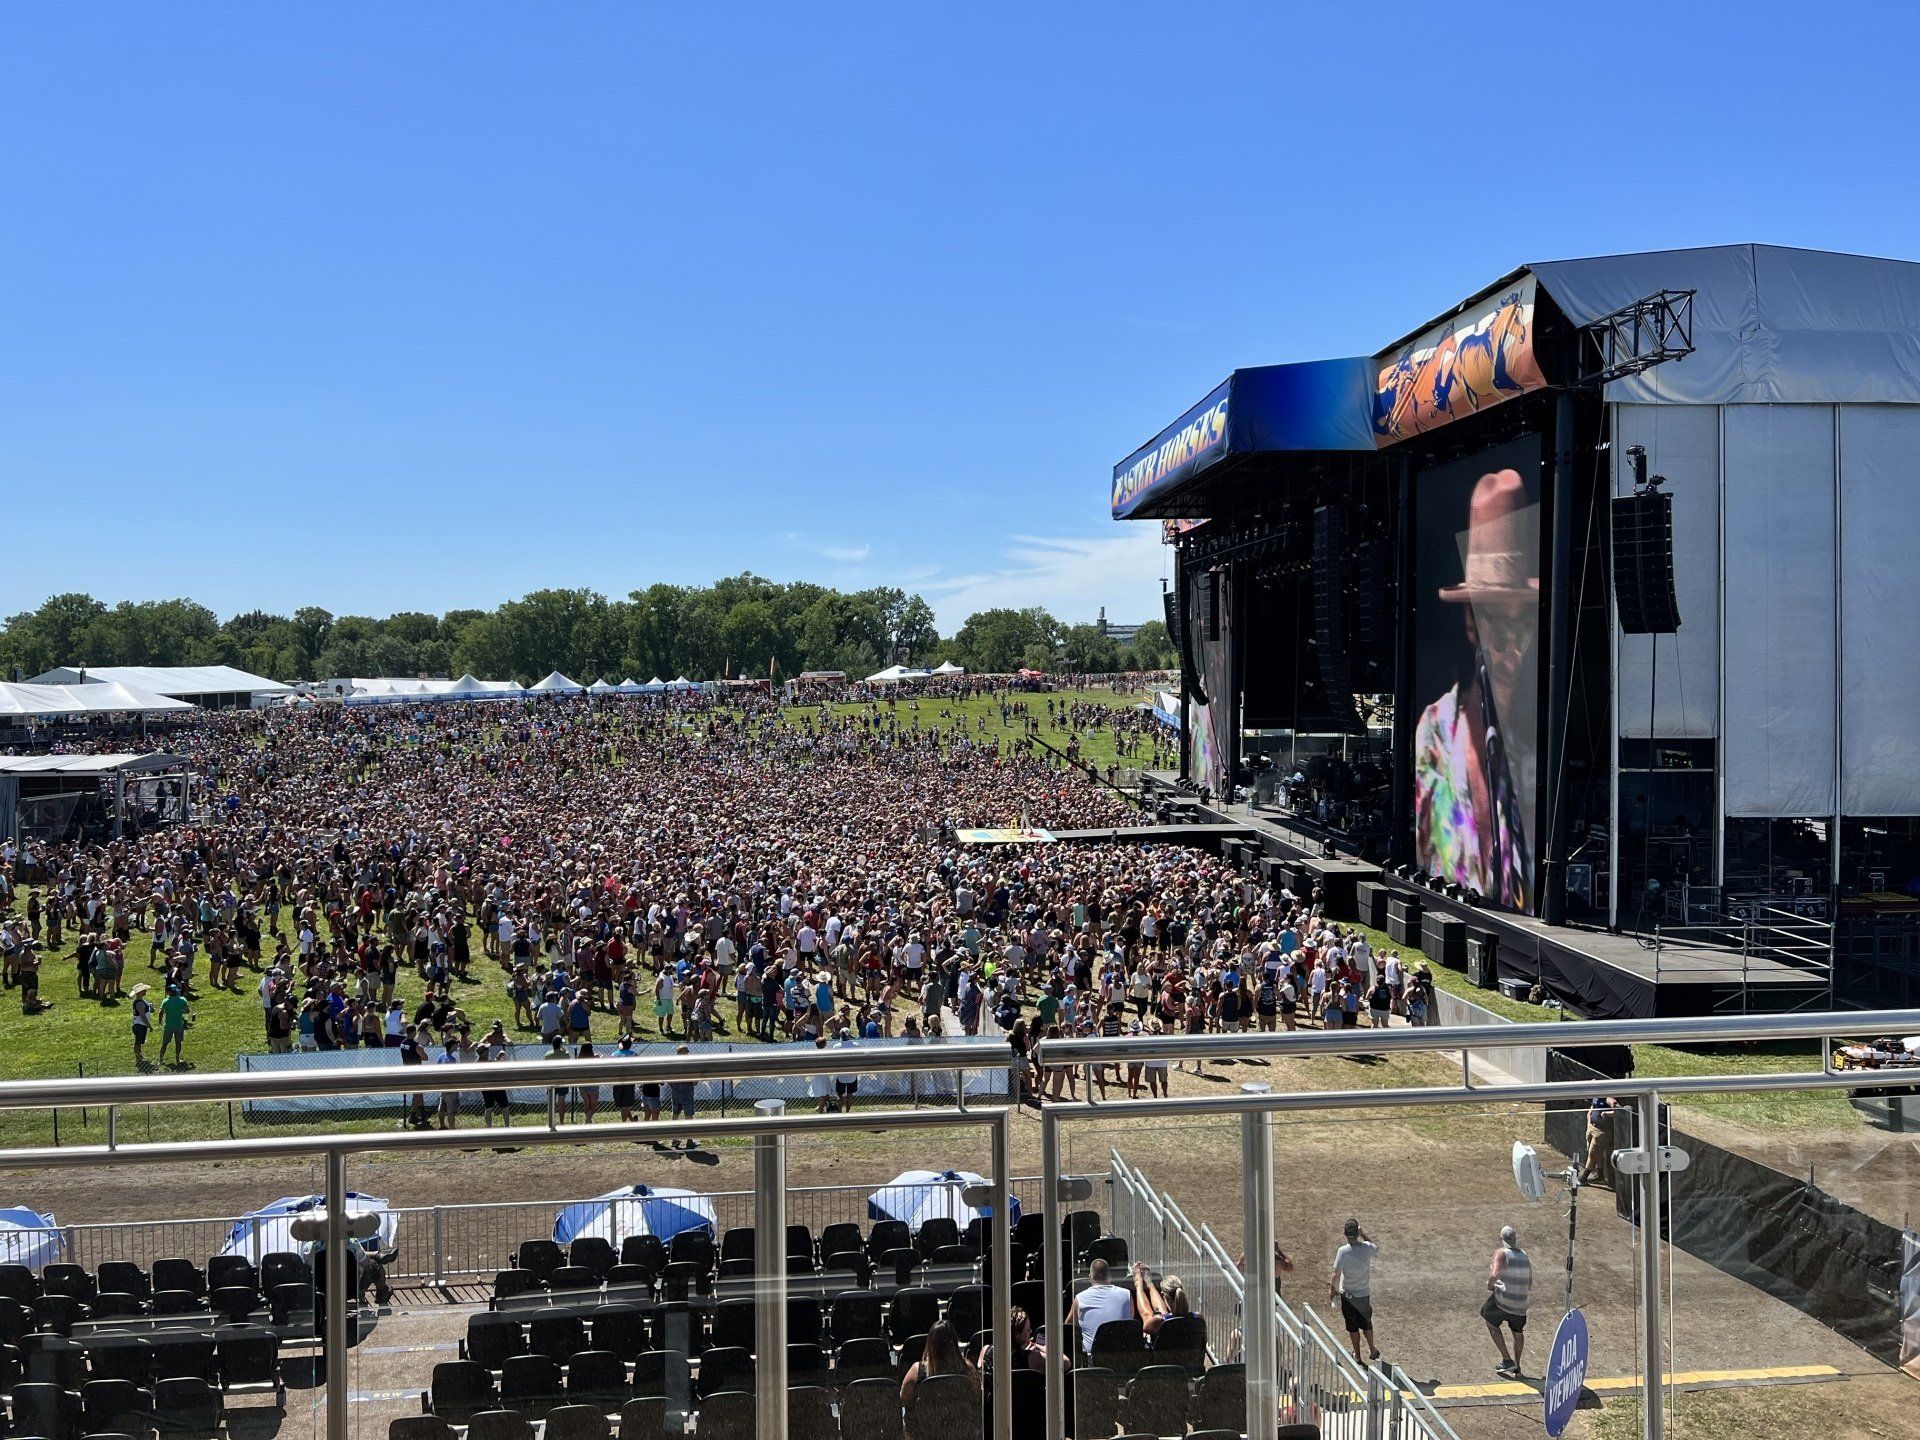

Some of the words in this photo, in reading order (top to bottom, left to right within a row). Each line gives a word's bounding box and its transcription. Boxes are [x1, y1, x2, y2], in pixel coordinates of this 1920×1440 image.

[1155, 397, 1228, 482] HORSES
[1560, 1334, 1577, 1373] ADA
[1548, 1359, 1585, 1416] VIEWING
